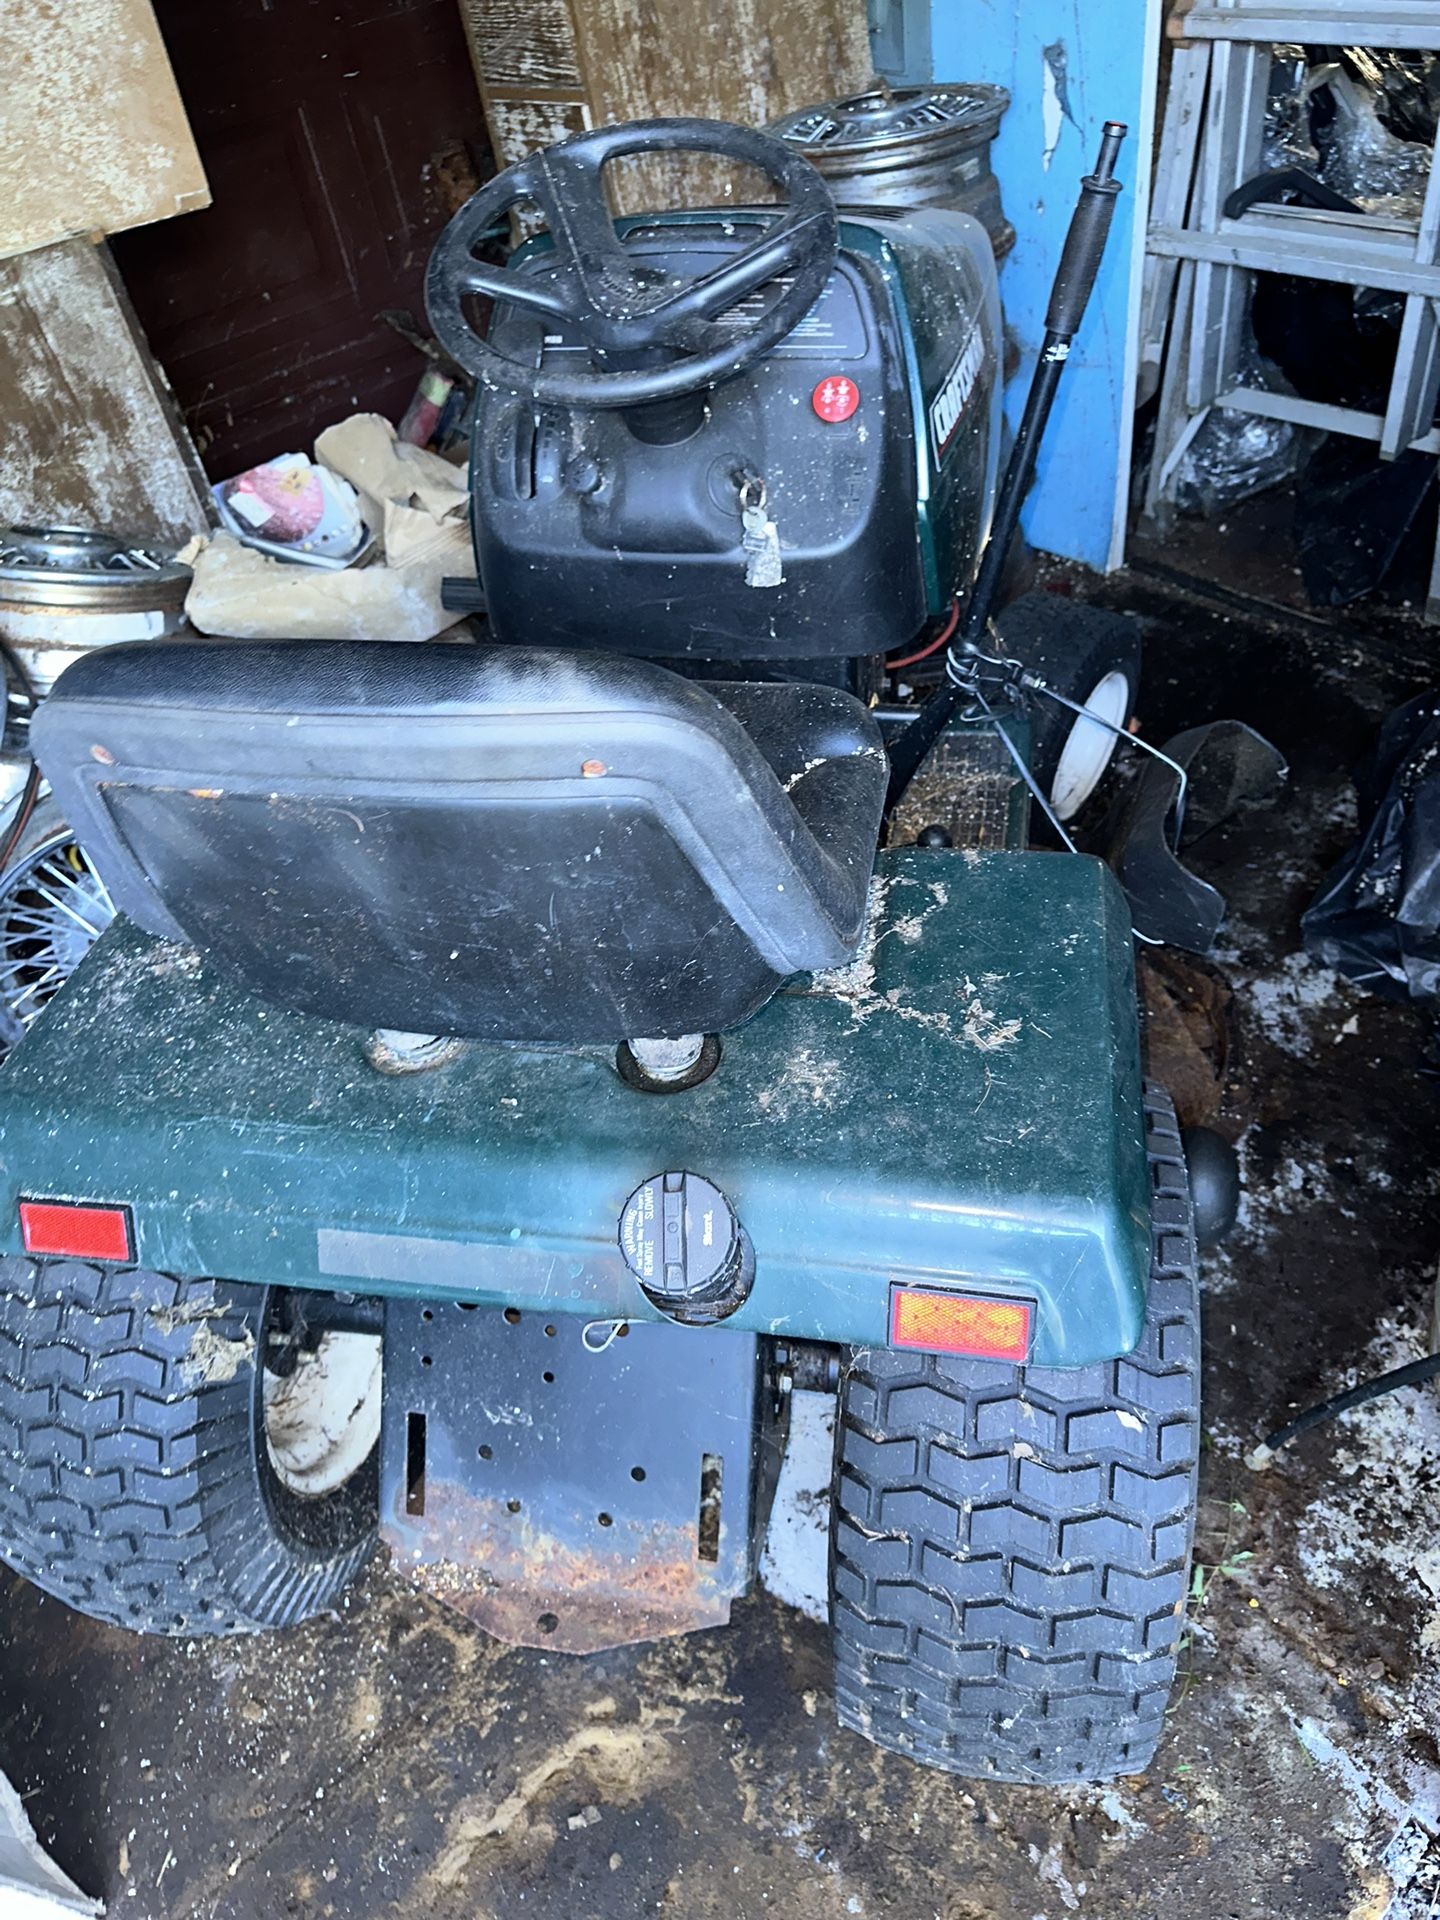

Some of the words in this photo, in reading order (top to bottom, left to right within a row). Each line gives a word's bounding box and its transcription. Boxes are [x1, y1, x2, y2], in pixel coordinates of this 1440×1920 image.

[644, 1186, 653, 1220] SLOWLY
[624, 1208, 637, 1255] WARNING
[644, 1240, 653, 1276] REMOVE
